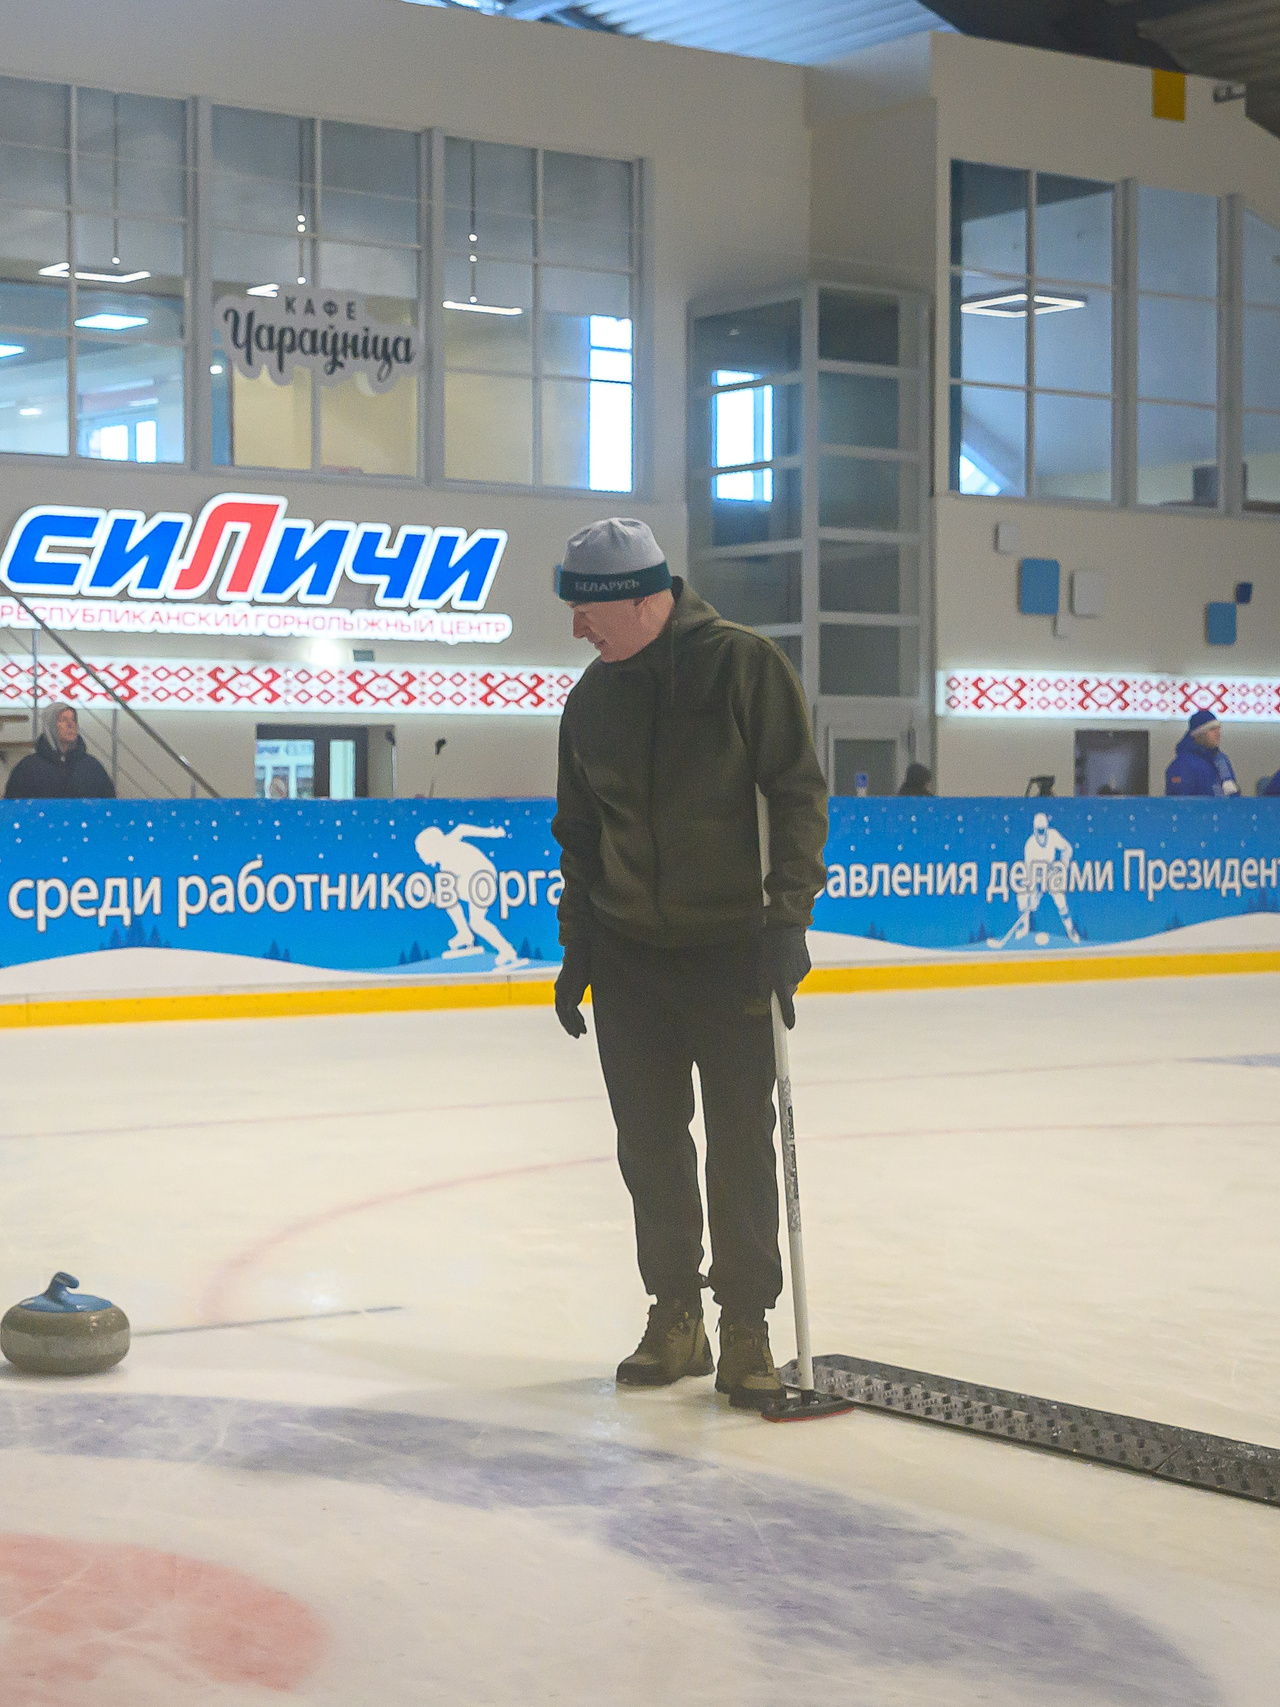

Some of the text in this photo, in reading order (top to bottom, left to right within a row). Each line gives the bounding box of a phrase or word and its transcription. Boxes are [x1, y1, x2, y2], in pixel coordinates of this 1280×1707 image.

[284, 296, 356, 320] КАФЕ
[0, 604, 506, 636] РЕСПУБЛИКАНСКИЙ ГОРНОЛЫЖНЫЙ ЦЕНТР
[8, 875, 162, 933] среди
[177, 858, 460, 929] работников
[813, 860, 978, 899] авления
[986, 857, 1115, 902] делами
[1123, 848, 1280, 902] Президен
